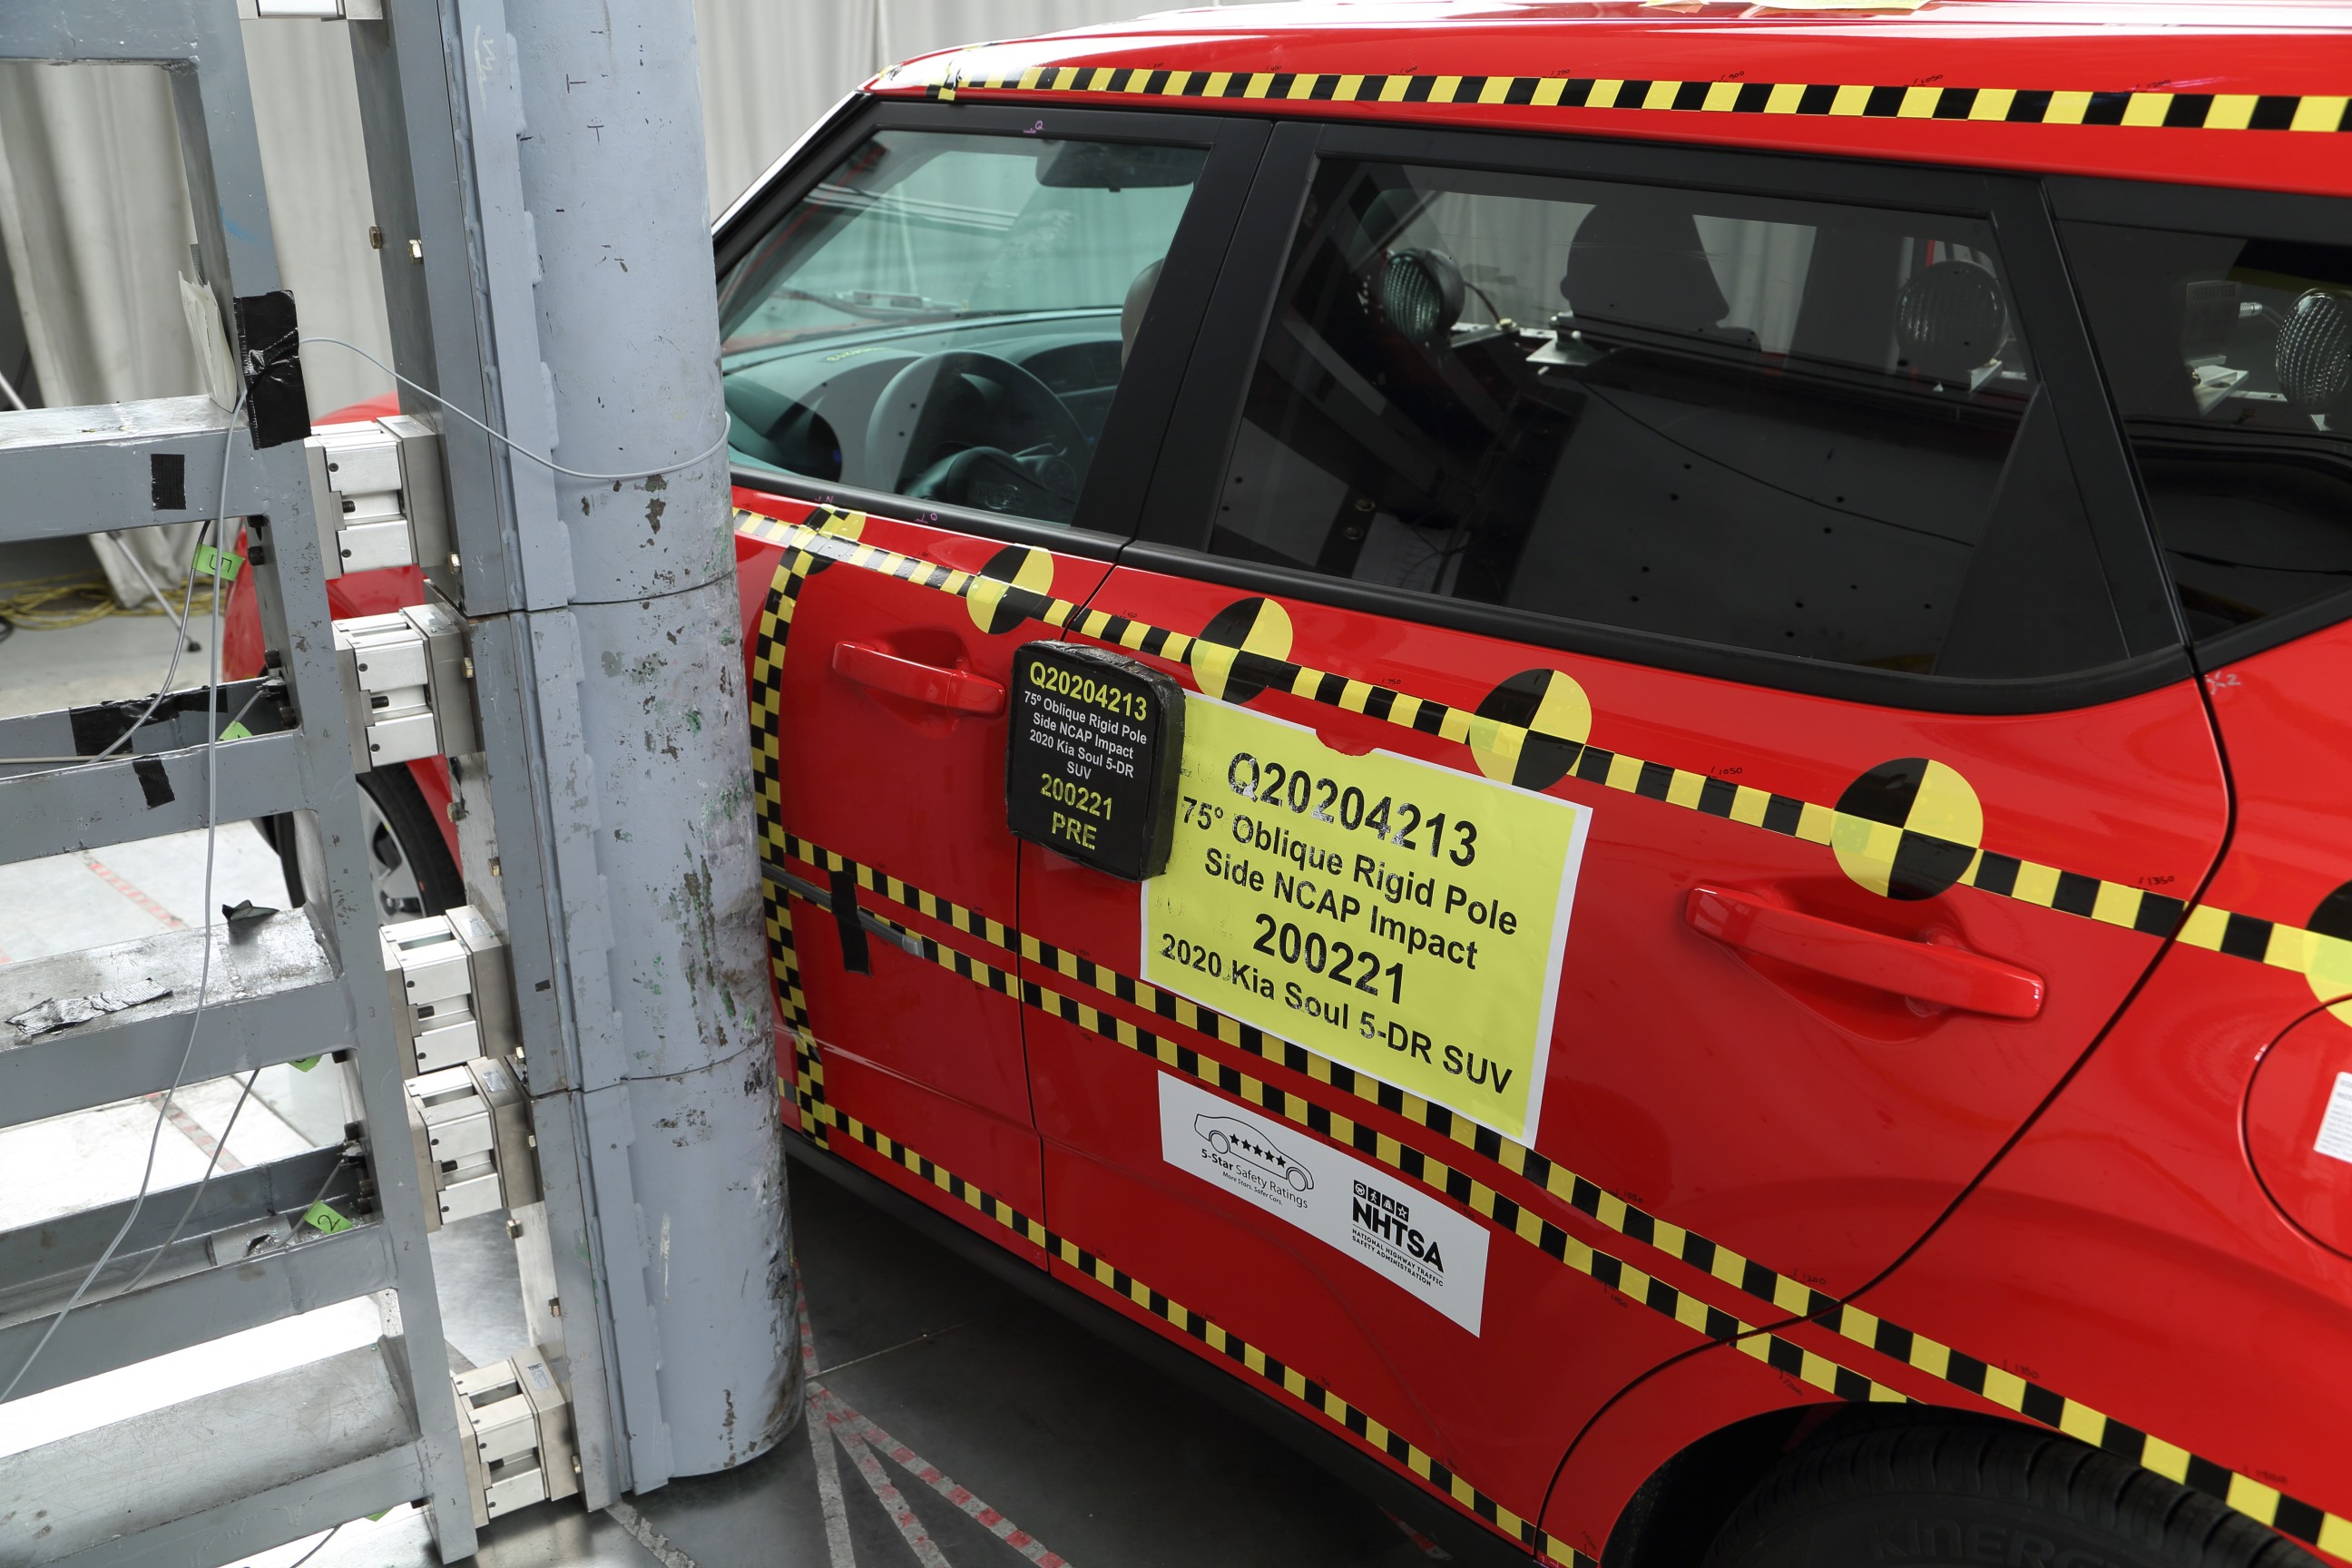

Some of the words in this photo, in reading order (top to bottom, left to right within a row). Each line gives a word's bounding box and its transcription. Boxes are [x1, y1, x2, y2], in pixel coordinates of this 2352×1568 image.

[1729, 71, 1744, 79] 900
[1921, 74, 1943, 83] 1050
[1030, 662, 1147, 721] Q20204213
[1033, 712, 1056, 731] Side
[1059, 721, 1093, 742] NCAP
[1094, 735, 1133, 760] Impact
[1044, 698, 1086, 723] Oblique
[1089, 713, 1118, 735] Rigid
[1122, 725, 1147, 745] Pole
[1029, 729, 1054, 748] 2020
[1056, 739, 1074, 756] Kia
[1078, 747, 1102, 767] Soul
[1105, 758, 1134, 779] 5-DR
[1066, 761, 1092, 779] SUV
[1040, 773, 1112, 820] 200221
[1228, 751, 1477, 867] Q20204213
[1052, 811, 1097, 850] PRE
[1232, 814, 1344, 876] Oblique
[1354, 854, 1434, 906] Rigid
[1446, 886, 1517, 936] Pole
[2149, 876, 2175, 886] 1350
[1205, 848, 1264, 892] Side
[1274, 873, 1360, 924] NCAP
[1370, 906, 1478, 970] Impact
[1252, 912, 1404, 1004] 200221
[1161, 933, 1221, 978] 2020
[1232, 960, 1274, 1000] Kia
[1285, 982, 1348, 1030] Soul
[1359, 1012, 1432, 1064] 5-DR
[1443, 1044, 1514, 1094] SUV
[1201, 1149, 1233, 1171] 5-Star
[1236, 1165, 1267, 1189] Safety
[1270, 1181, 1308, 1208] Ratings
[1223, 1171, 1237, 1181] More
[1238, 1180, 1253, 1191] Stars.
[1254, 1187, 1269, 1197] Safer
[1269, 1195, 1282, 1205] Cars.
[1624, 1191, 1643, 1204] 1050
[318, 1214, 340, 1231] 2
[403, 1241, 409, 1250] 2
[1352, 1196, 1445, 1273] NHTSA
[1352, 1236, 1375, 1251] SAFETY
[1377, 1250, 1431, 1286] ADMINISTRATION
[1353, 1229, 1384, 1250] NATIONAL
[1386, 1248, 1416, 1269] HIGHWAY
[1417, 1266, 1443, 1287] TRAFFIC
[1803, 1273, 1827, 1285] 1200
[1611, 1294, 1628, 1308] 1050
[2014, 1364, 2040, 1379] 1350
